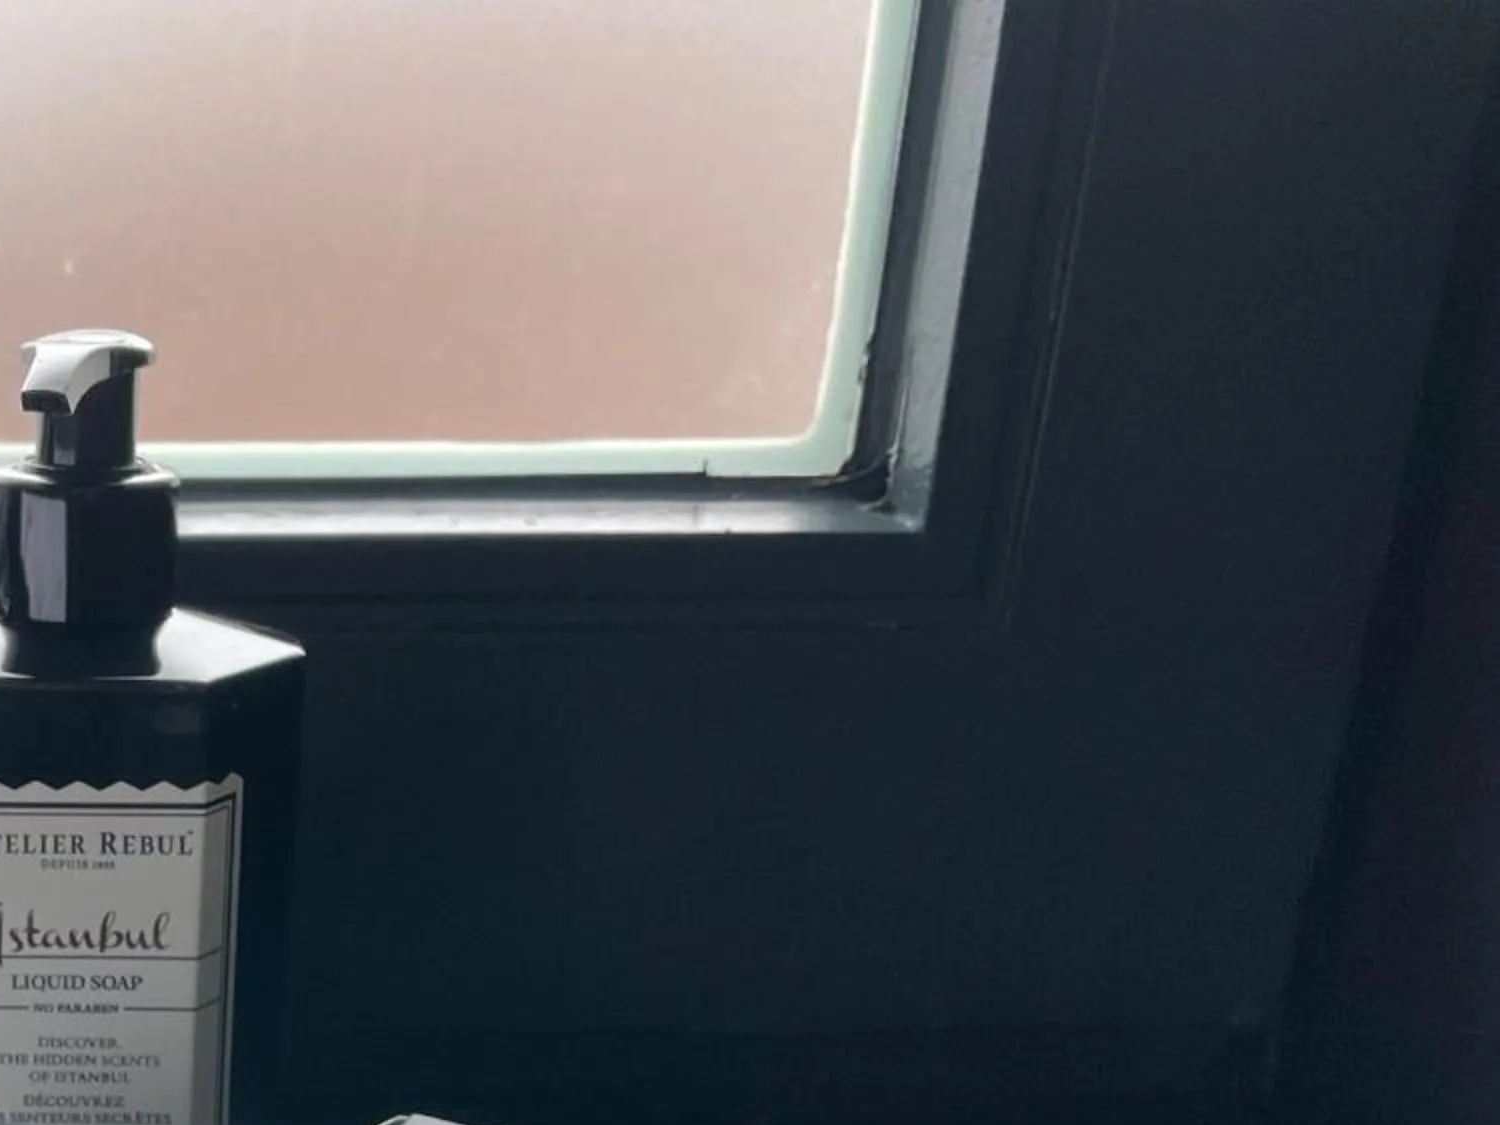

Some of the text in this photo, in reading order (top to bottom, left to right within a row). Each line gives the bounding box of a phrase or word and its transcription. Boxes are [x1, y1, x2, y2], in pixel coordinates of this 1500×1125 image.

[100, 831, 193, 856] REBUL
[11, 973, 143, 992] LIQUID SOAP
[37, 1036, 120, 1049] DISCOVER
[33, 1053, 98, 1066] HIDDEN
[101, 1054, 161, 1068] SCENTS
[28, 1070, 131, 1084] OF ISTANBUL
[9, 1111, 90, 1125] SENTEURS
